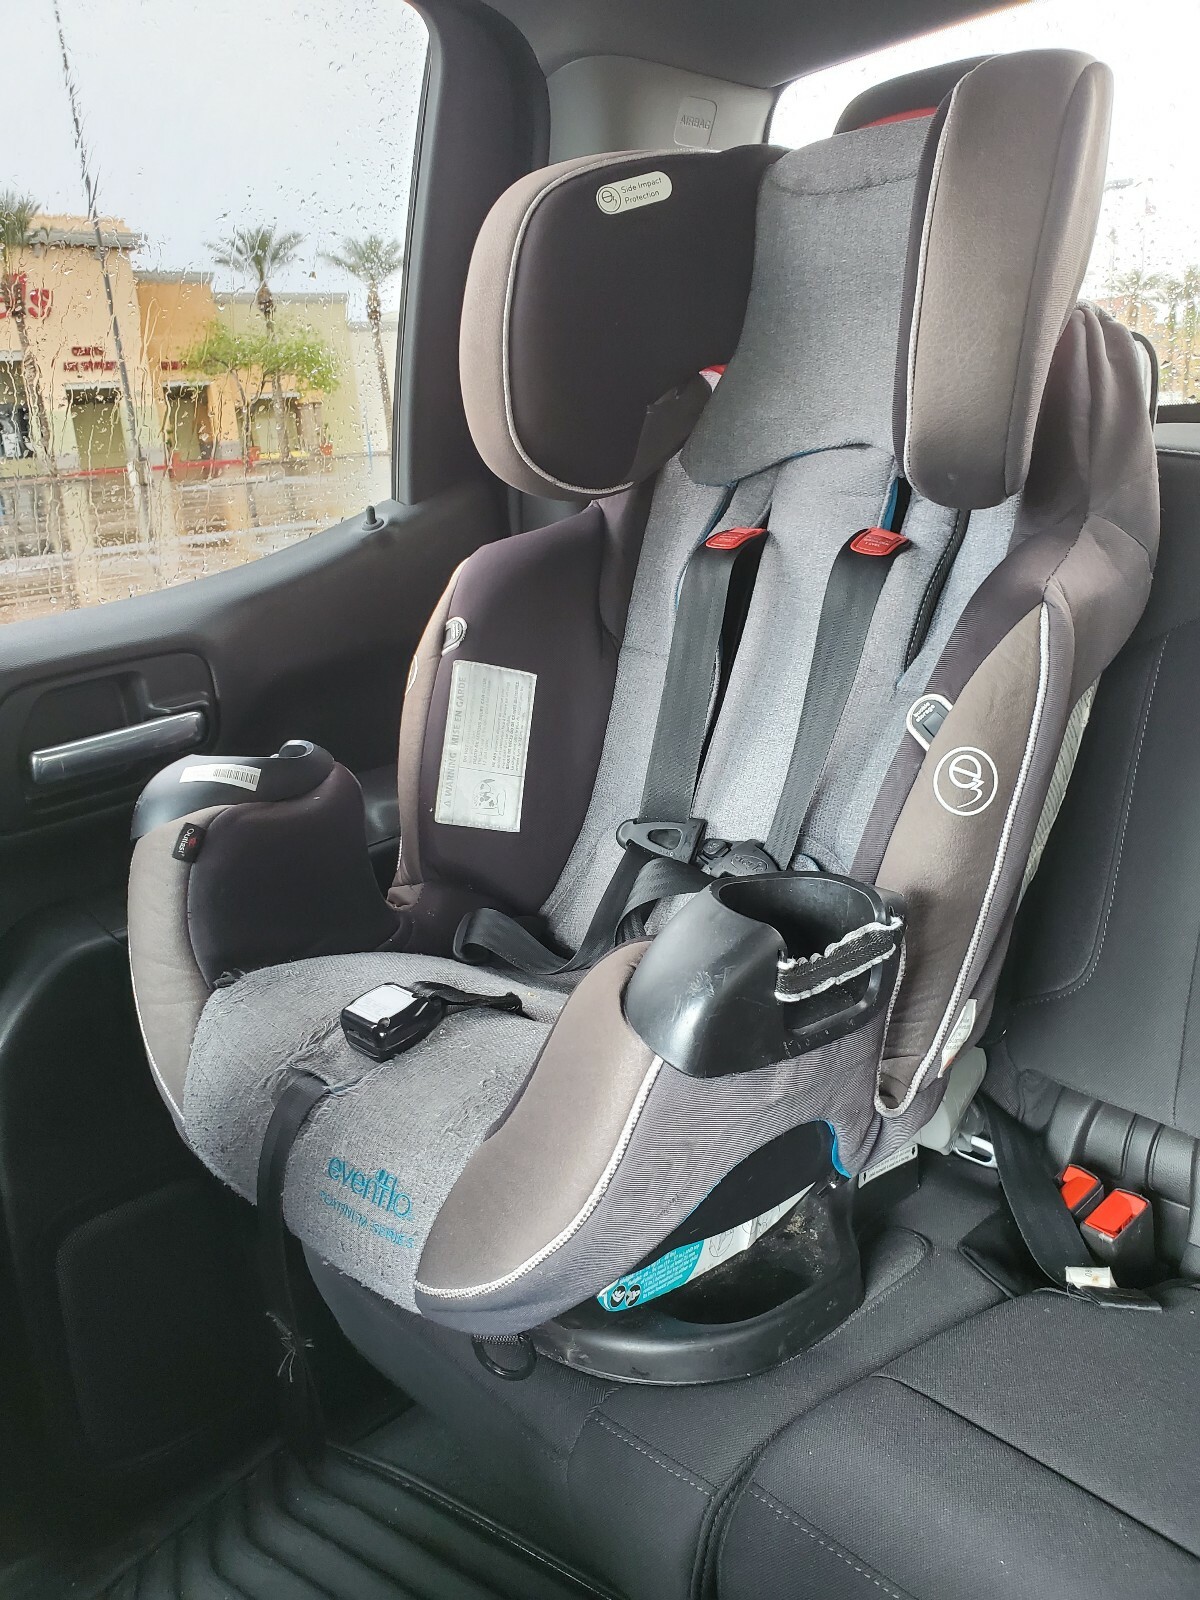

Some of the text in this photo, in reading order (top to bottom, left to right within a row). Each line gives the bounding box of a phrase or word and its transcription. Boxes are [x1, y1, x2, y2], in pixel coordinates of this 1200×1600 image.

[680, 115, 711, 130] AIRBAG
[620, 177, 662, 194] Side Impact
[624, 190, 660, 205] Protection
[445, 676, 467, 797] WARNING MISE EN GARDE
[328, 1157, 412, 1218] evenflo
